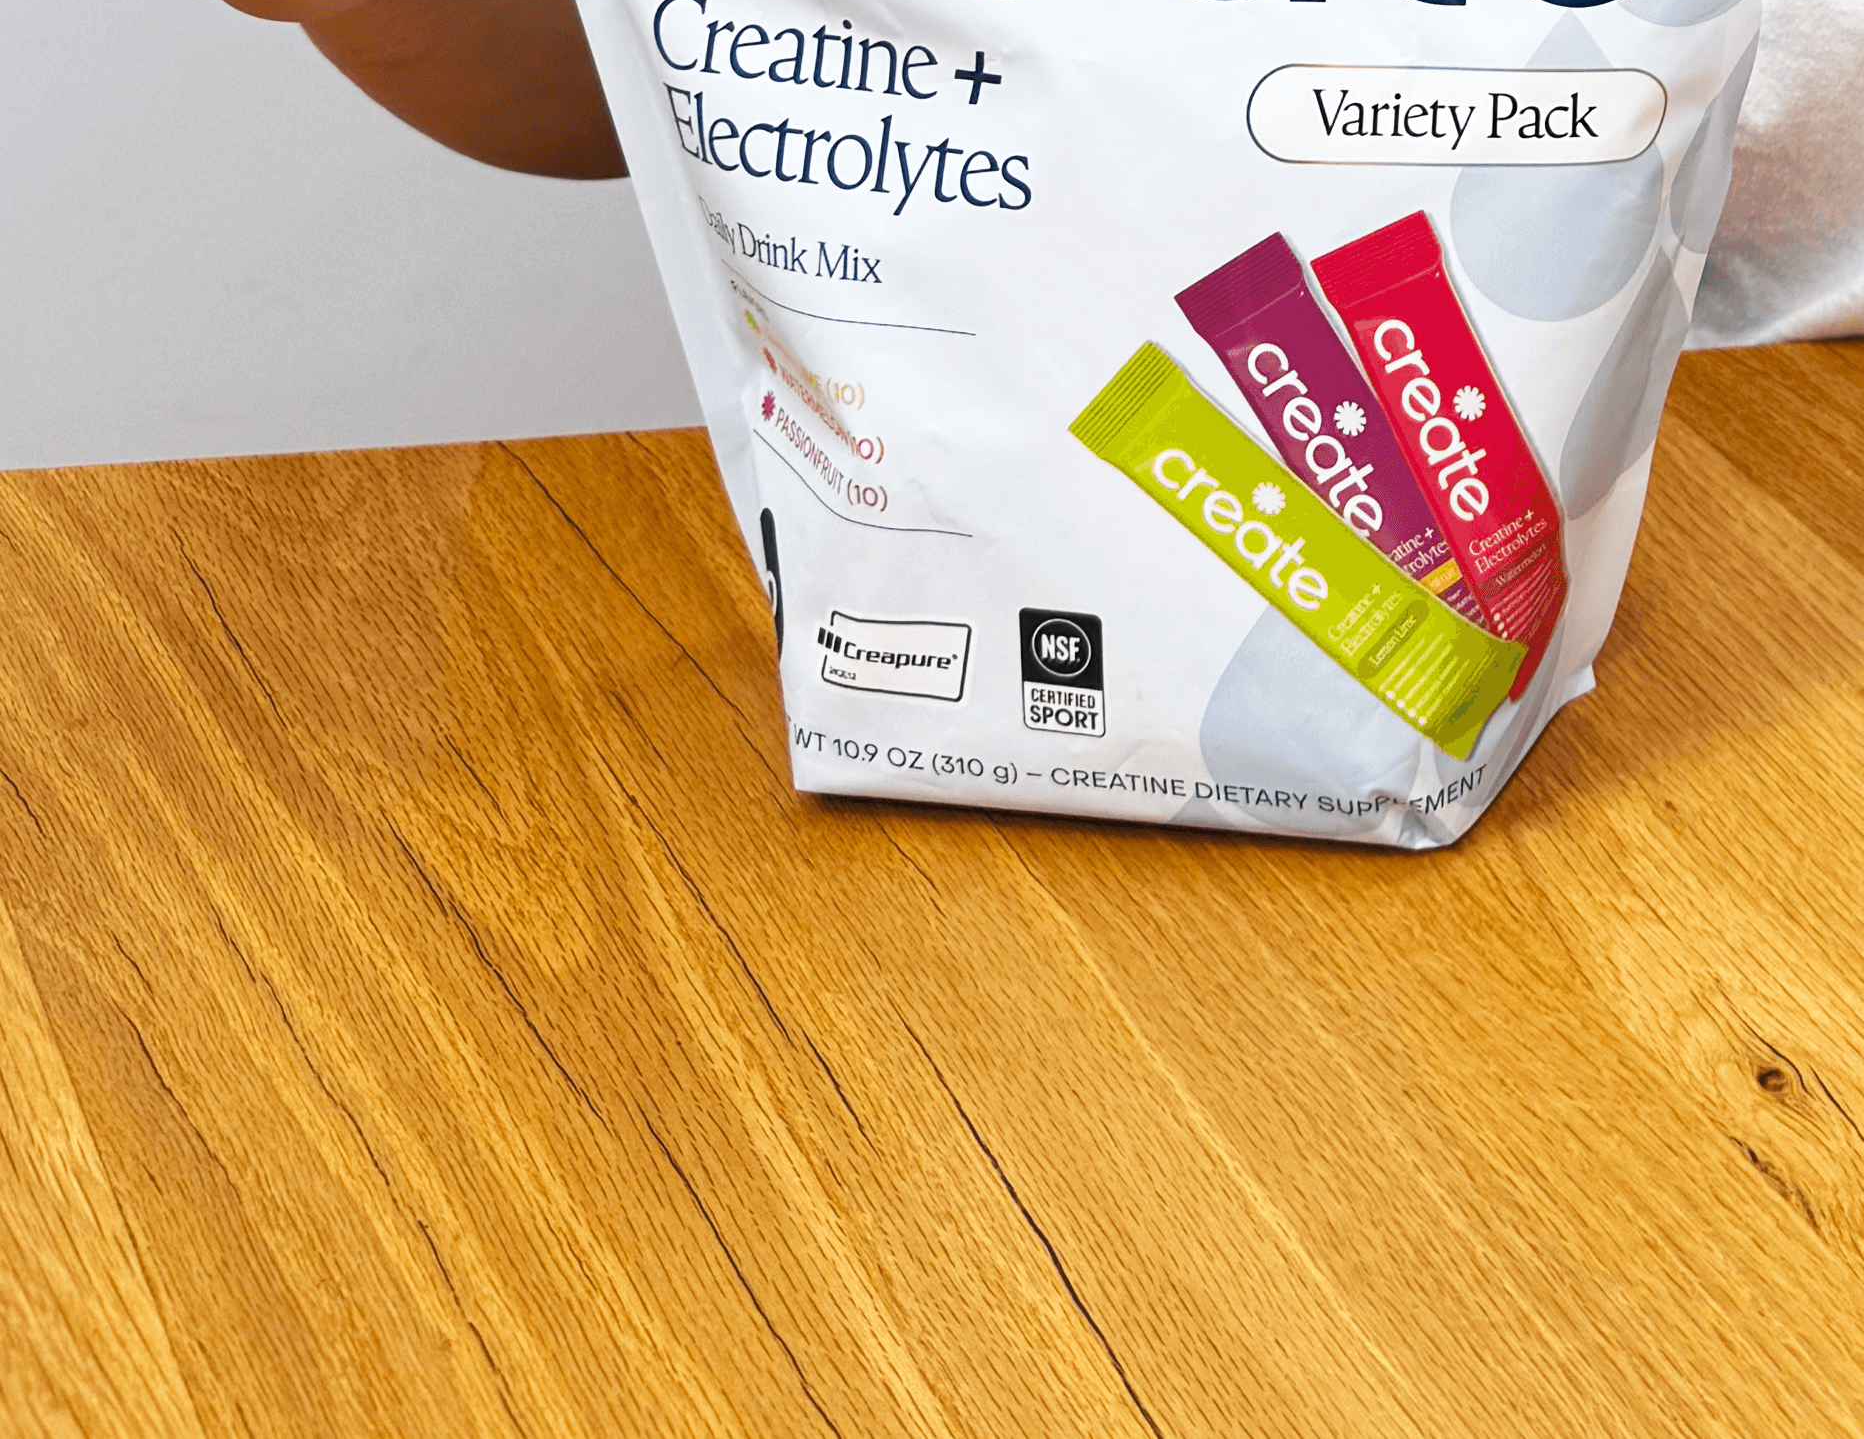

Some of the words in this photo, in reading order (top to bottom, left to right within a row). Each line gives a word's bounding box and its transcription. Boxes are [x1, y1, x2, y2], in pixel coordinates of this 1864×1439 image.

[955, 51, 1002, 104] +
[664, 82, 1032, 216] Electrolytes
[1313, 88, 1475, 151] Variety
[1487, 92, 1598, 140] Pack
[737, 222, 809, 275] Drink
[815, 241, 883, 284] Mix
[1247, 342, 1384, 539] create
[1373, 319, 1490, 521] create
[774, 407, 845, 495] PASSIONFRUIT
[847, 478, 888, 512] (10)
[1152, 448, 1330, 611] create
[1391, 534, 1425, 563] atine
[1469, 516, 1525, 555] Creatine
[1474, 518, 1548, 574] Electrolytes
[1030, 705, 1098, 730] SPORT
[1031, 688, 1096, 710] CERTIFIED
[793, 723, 826, 753] WT
[833, 738, 878, 763] 10.9
[887, 746, 925, 771] OZ
[932, 753, 984, 777] (310
[993, 762, 1018, 785] g)
[1050, 766, 1187, 799] CREATINE
[1196, 779, 1308, 812] DIETARY
[1318, 764, 1488, 816] SUPPEMENT
